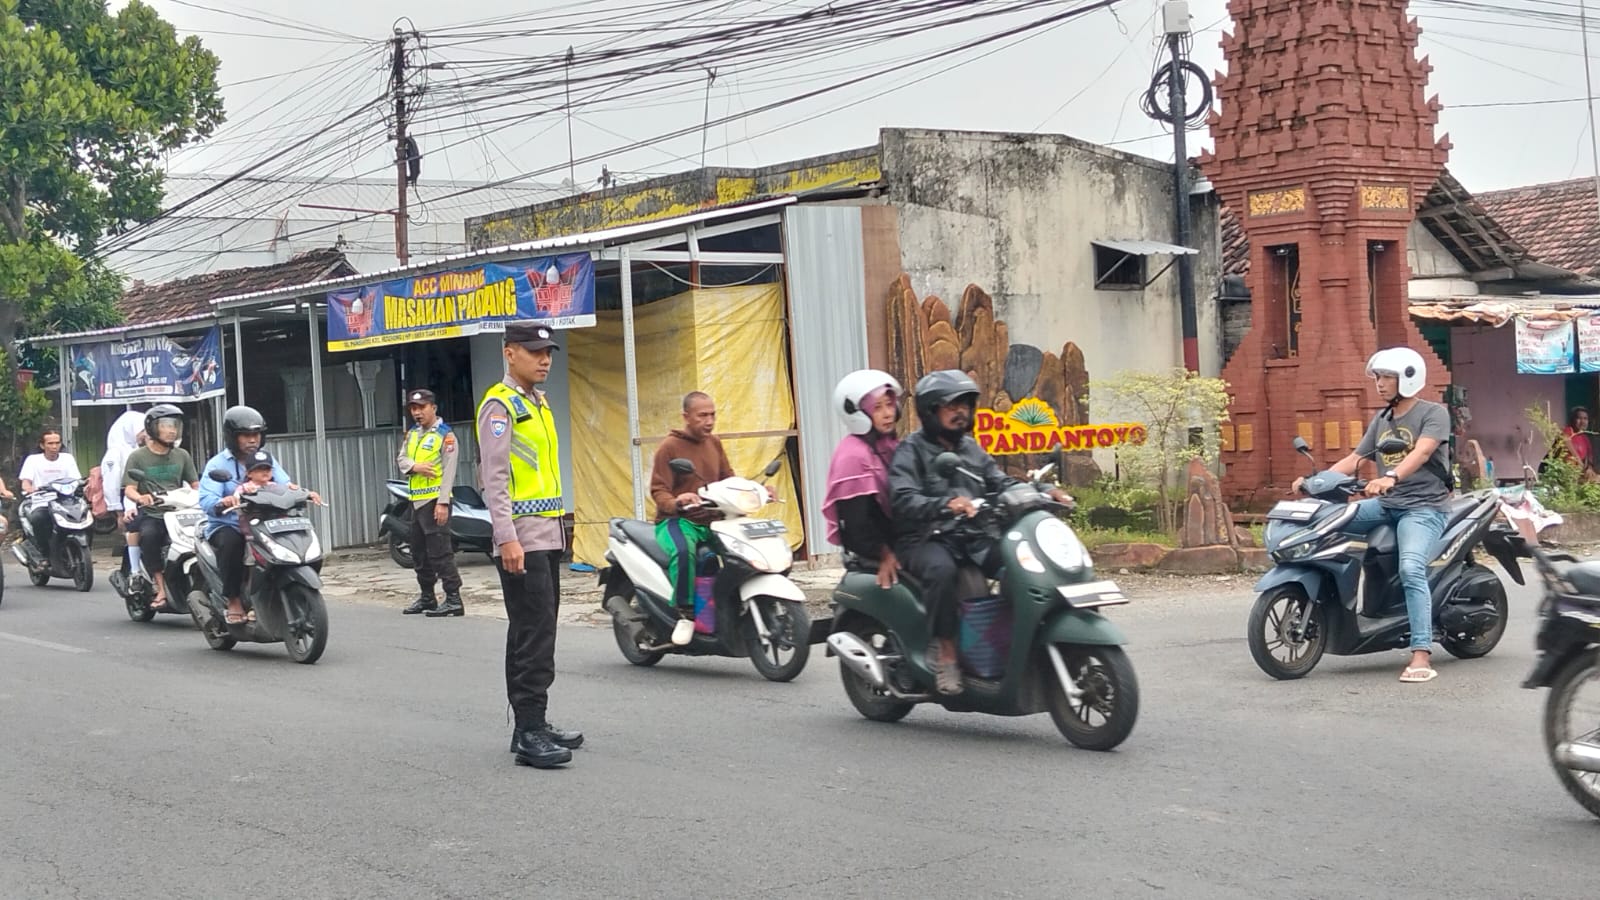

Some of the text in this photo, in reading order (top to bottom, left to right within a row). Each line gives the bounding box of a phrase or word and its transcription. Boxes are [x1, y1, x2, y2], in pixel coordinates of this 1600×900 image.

[413, 268, 485, 298] ACC MINANG
[384, 276, 518, 331] MASAKAN PADANG
[976, 412, 1011, 432] Ds.
[978, 426, 1147, 453] PANDANTOYO
